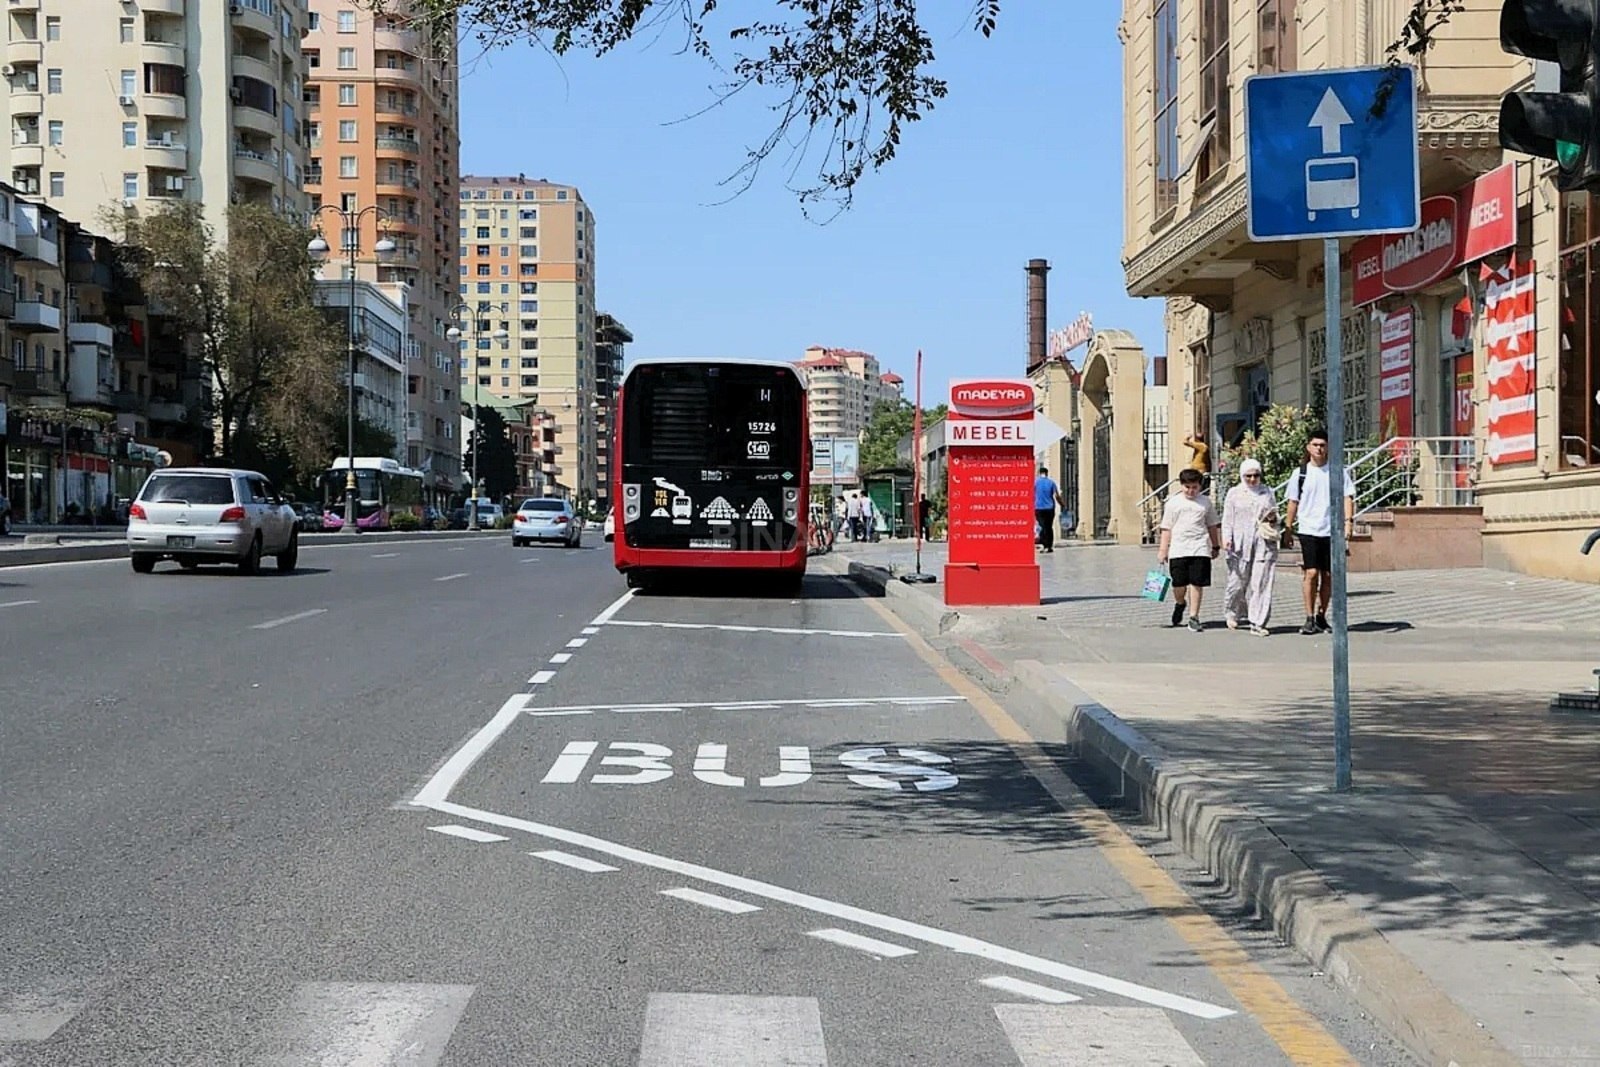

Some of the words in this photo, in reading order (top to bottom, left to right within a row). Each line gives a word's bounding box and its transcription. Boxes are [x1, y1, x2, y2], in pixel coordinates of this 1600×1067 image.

[1469, 196, 1504, 231] MEBEL
[957, 389, 1026, 400] MADEYRA
[747, 421, 776, 432] 15726
[952, 426, 1027, 440] MEBEL
[751, 443, 767, 453] 141
[540, 740, 960, 792] BUS
